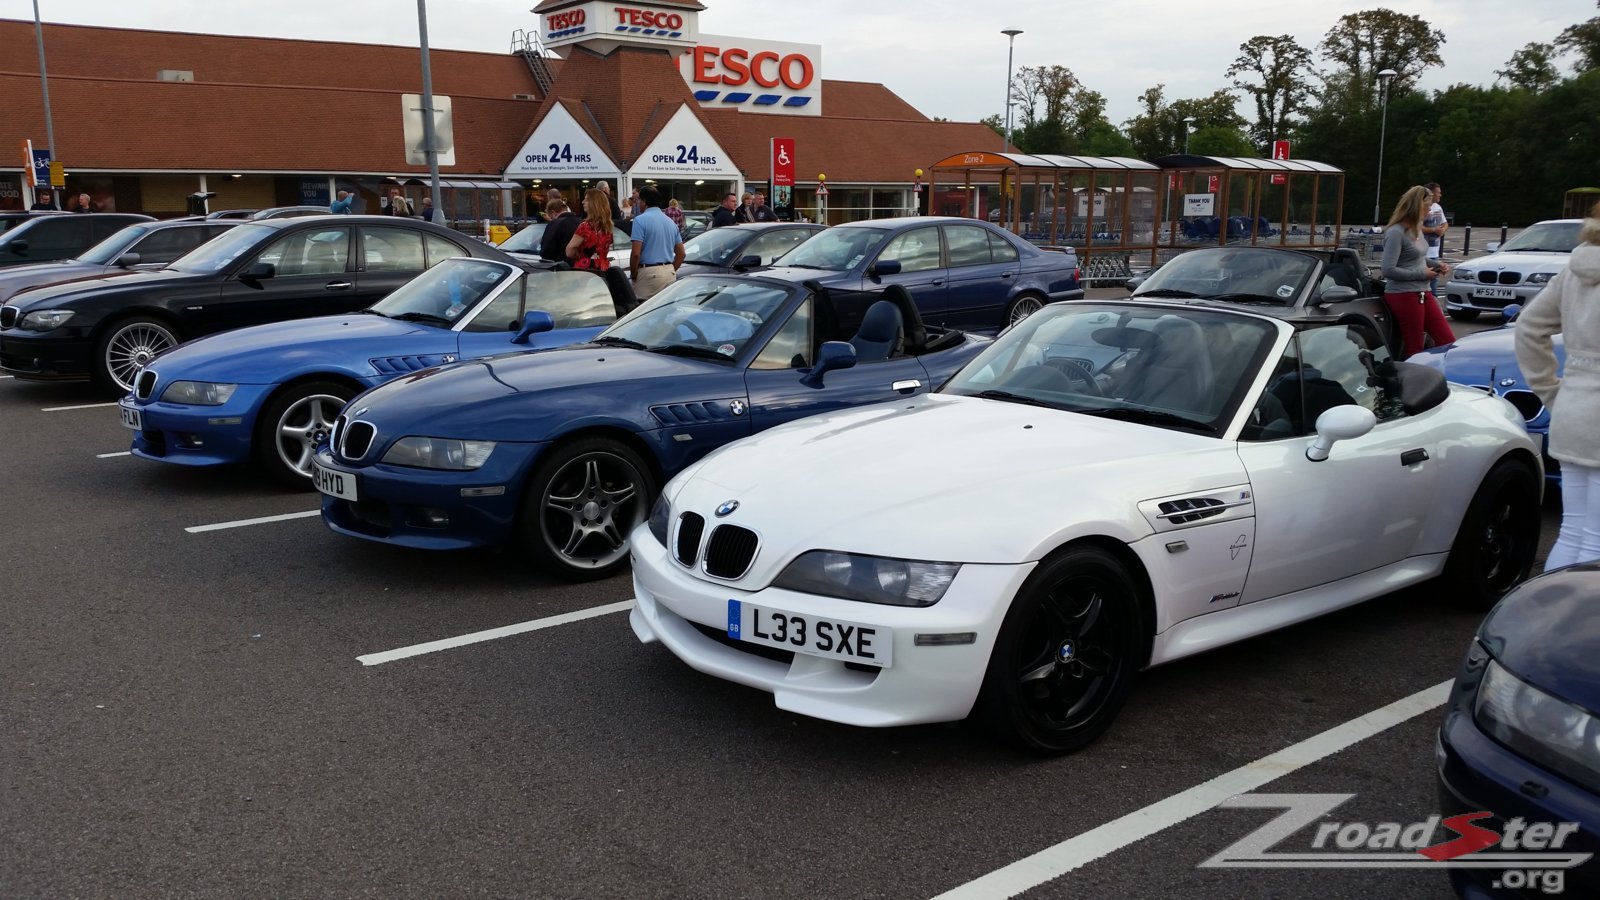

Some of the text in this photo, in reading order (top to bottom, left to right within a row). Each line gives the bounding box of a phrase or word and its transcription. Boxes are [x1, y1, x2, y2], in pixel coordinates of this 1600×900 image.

[547, 8, 586, 31] TESCO
[614, 7, 683, 30] TESCO
[525, 143, 592, 163] OPEN 24 HRS
[652, 144, 717, 165] OPEN 24 HRS
[964, 154, 984, 164] Zone 2
[1476, 288, 1512, 297] MF52 YVM
[123, 408, 139, 427] FLN
[321, 470, 344, 494] HYD
[729, 623, 739, 633] GB
[753, 608, 876, 659] L33 SXE
